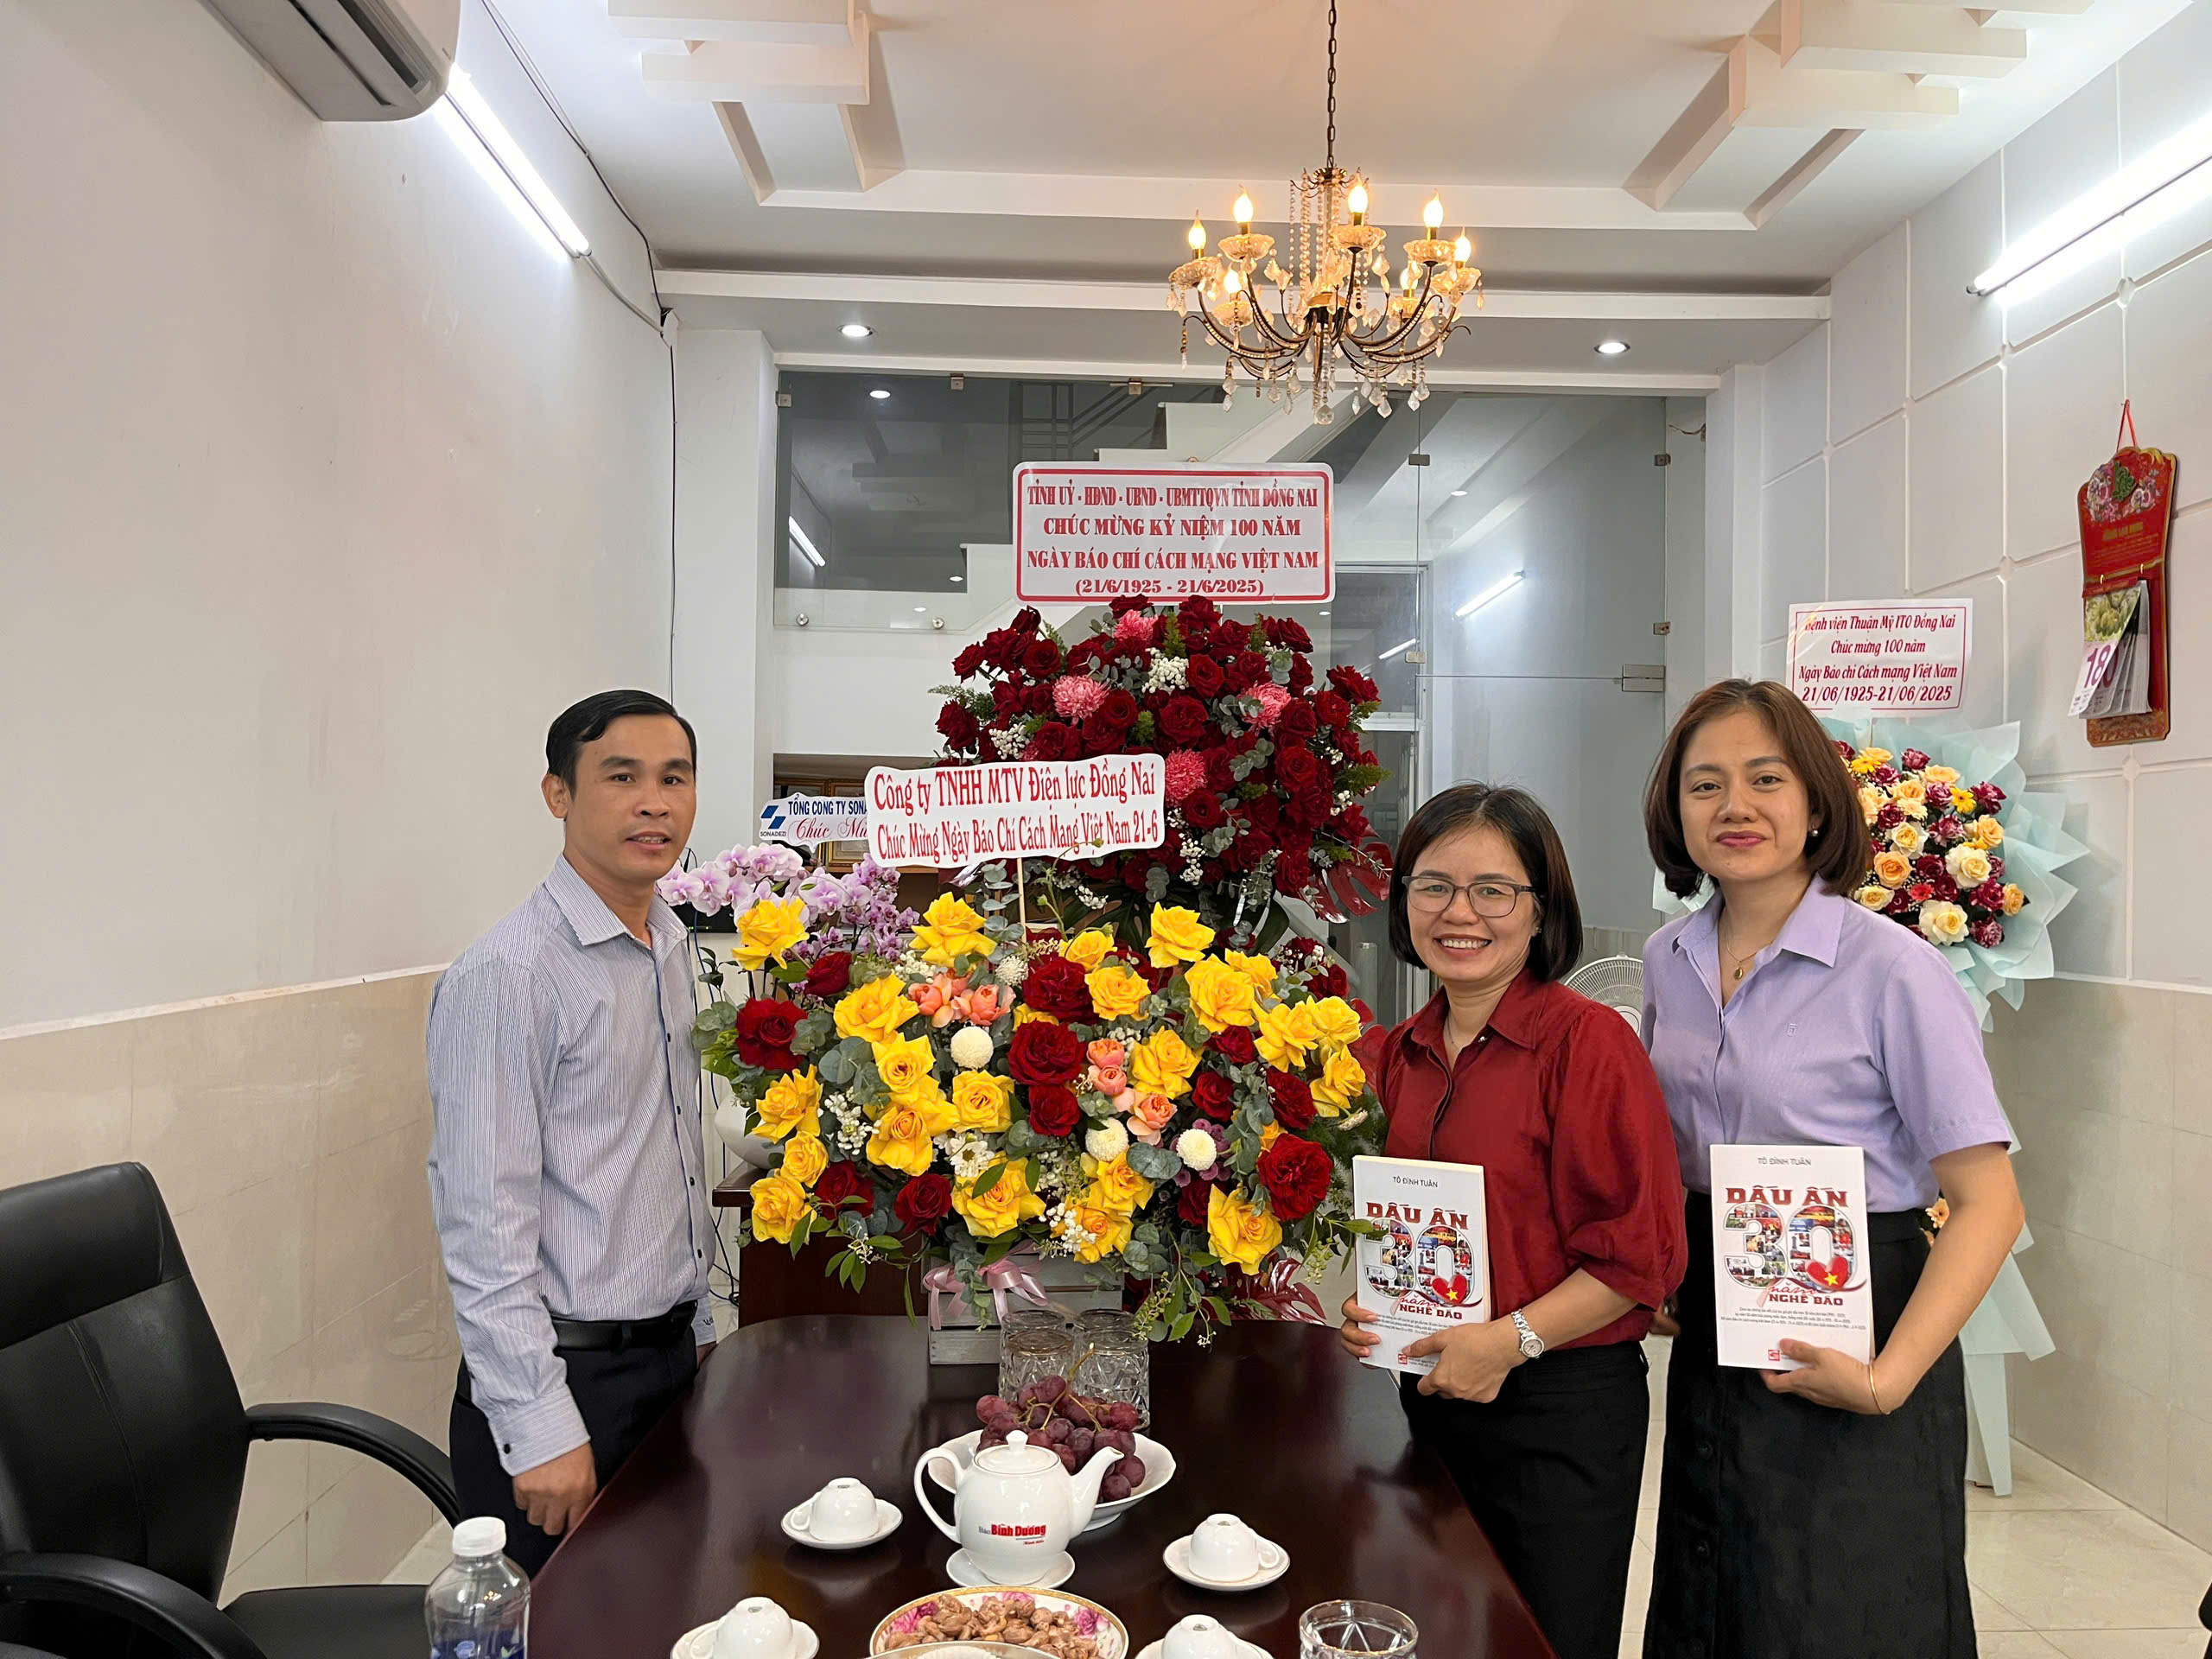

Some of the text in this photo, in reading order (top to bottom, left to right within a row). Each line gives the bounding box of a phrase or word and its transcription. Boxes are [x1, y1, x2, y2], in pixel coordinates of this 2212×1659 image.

[1027, 479, 1056, 505] TỈNH
[1084, 486, 1116, 505] HĐND
[1126, 486, 1157, 506] UBND
[1166, 487, 1229, 512] UBMTTQVN
[1262, 479, 1294, 507] ĐỒNG
[1297, 488, 1318, 507] NAI
[1044, 513, 1301, 541] CHÚC MỪNG KỶ NIỆM 100 NĂM
[1027, 546, 1319, 574] NGÀY BÁO CHÍ CÁCH MẠNG VIỆT NAM
[1075, 579, 1161, 596] (21/6/1925
[1177, 579, 1264, 595] 21/6/2025)
[1829, 615, 1847, 634] viện
[1850, 615, 1878, 633] Thuận
[1896, 614, 1912, 629] ITO
[1939, 613, 1956, 628] Nai
[1831, 639, 1853, 654] Chúc
[1885, 639, 1904, 653] 100
[1904, 639, 1926, 652] năm
[1799, 663, 1957, 683] Ngày Báo chí Cách mạng Việt Nam
[2083, 645, 2111, 689] 18
[874, 758, 1155, 817] Công ty TNHH MTV Điện lực Đồng Nai
[788, 793, 810, 815] TỔNG
[836, 800, 847, 815] TY
[790, 817, 832, 842] Chúc
[877, 809, 1159, 864] Chúc Mừng Ngày Báo Chí Cách Mạng Việt Nam 21-6
[1723, 1201, 1857, 1294] 30
[991, 1523, 1014, 1536] Bình
